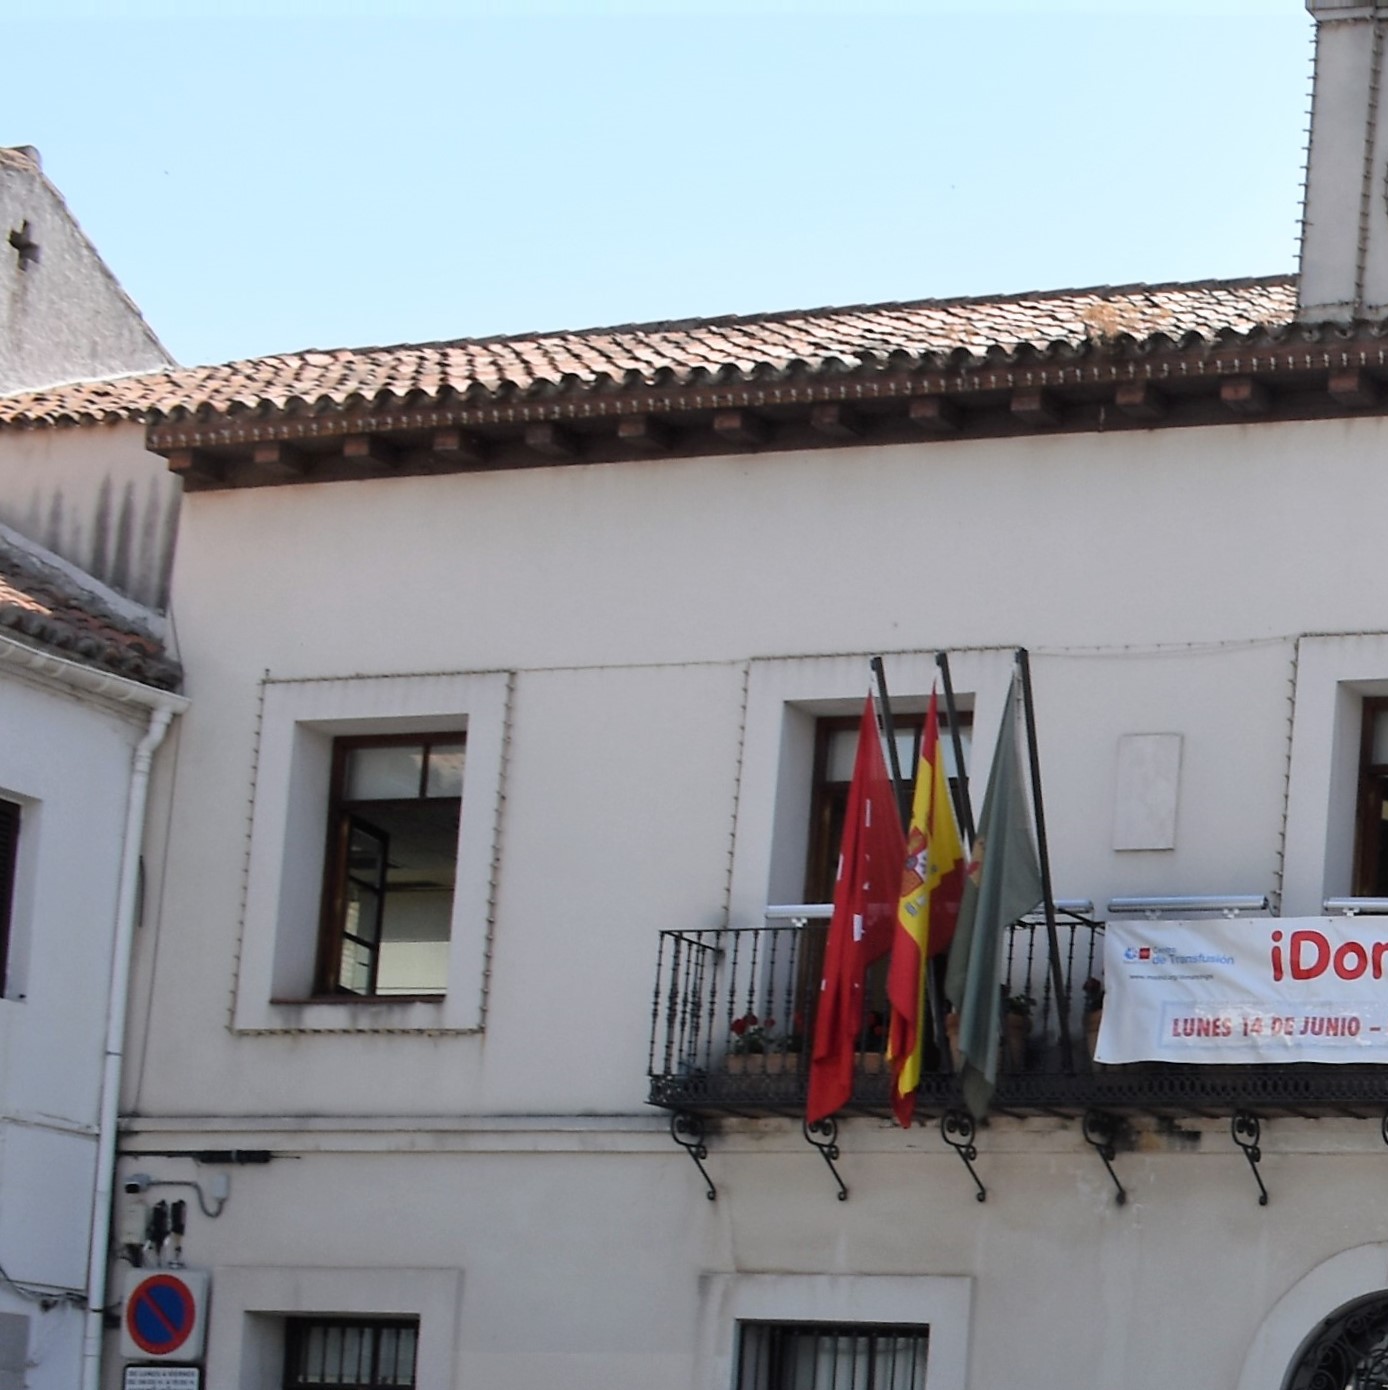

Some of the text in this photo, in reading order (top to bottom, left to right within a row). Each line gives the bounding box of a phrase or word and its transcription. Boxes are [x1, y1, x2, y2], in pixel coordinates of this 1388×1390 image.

[1152, 953, 1235, 965] de Transfusión
[1172, 1017, 1232, 1038] LUNES
[1270, 1017, 1296, 1037] DE
[1299, 1016, 1361, 1037] JUNIO
